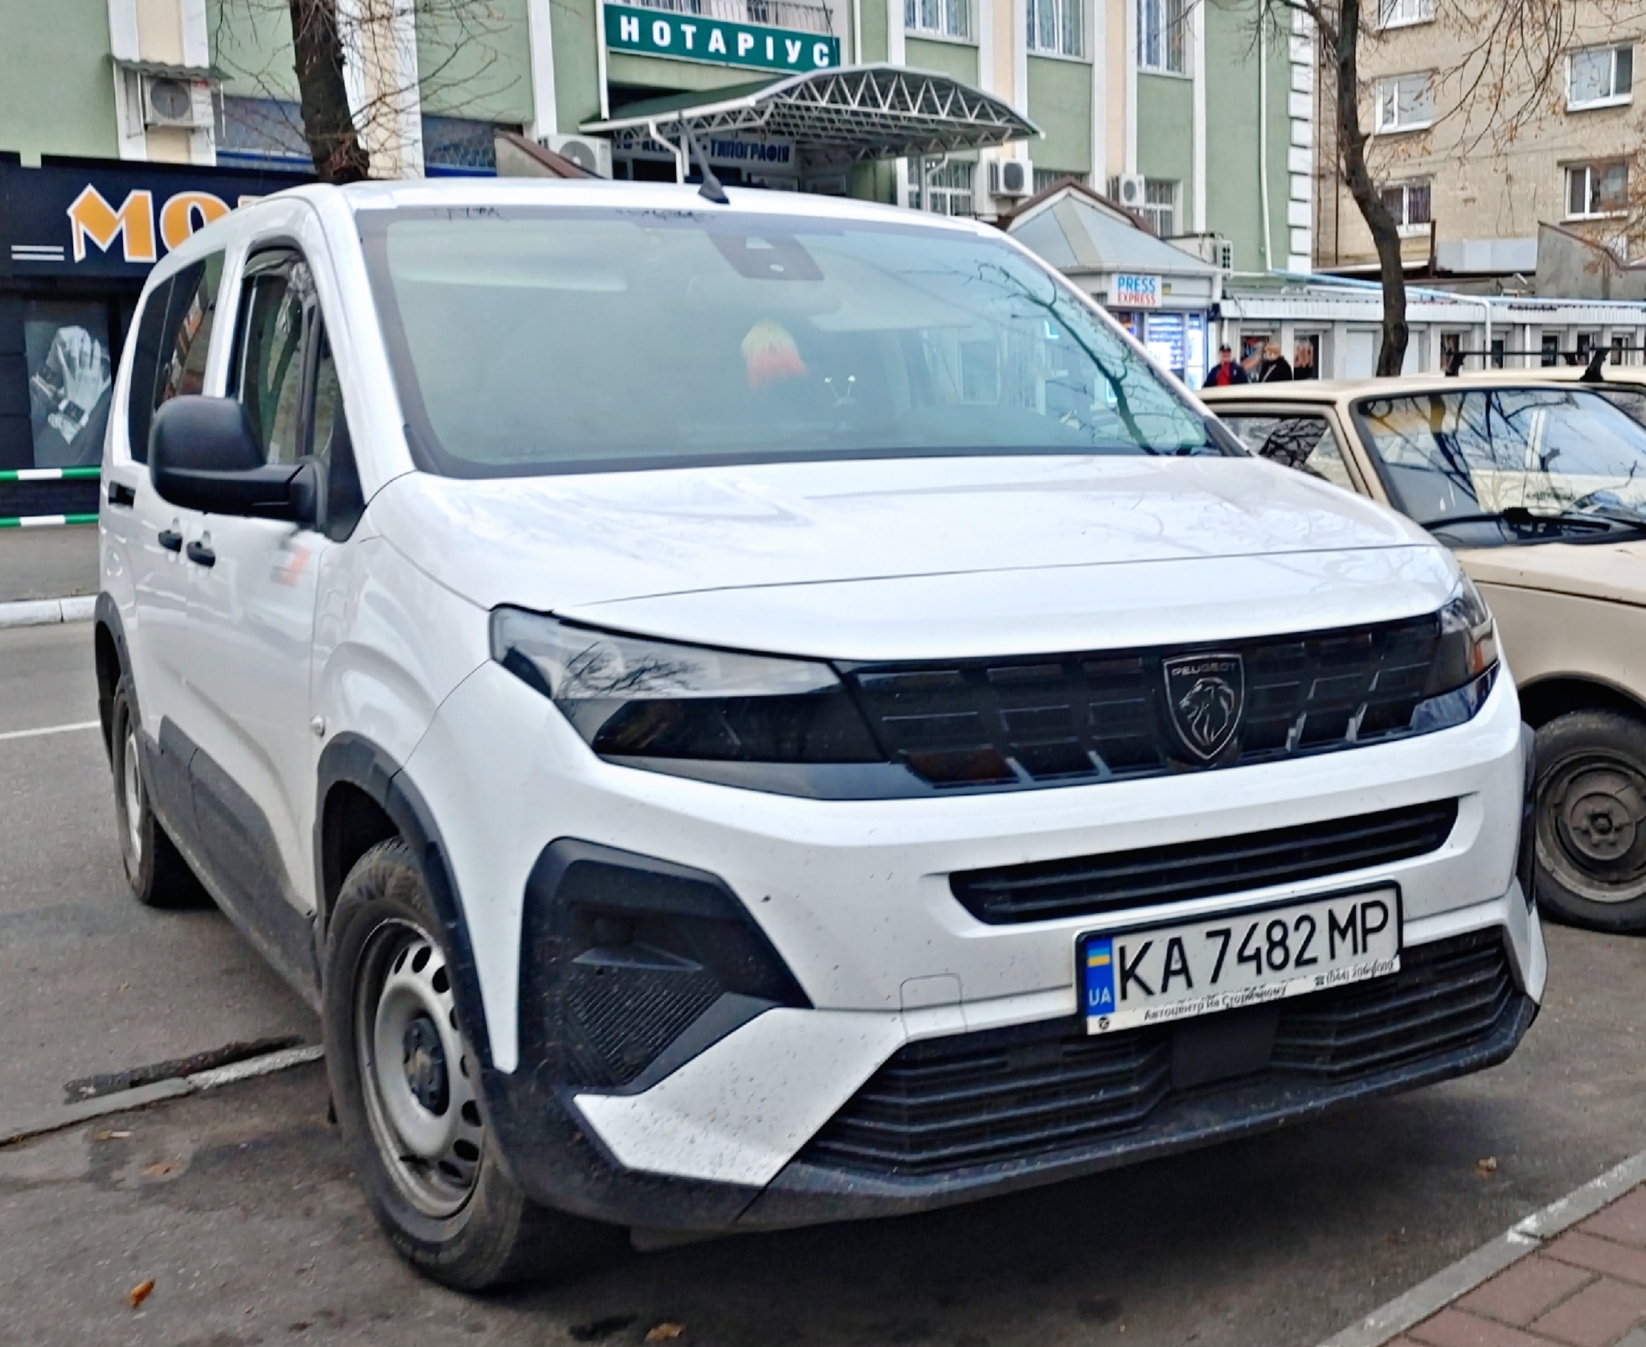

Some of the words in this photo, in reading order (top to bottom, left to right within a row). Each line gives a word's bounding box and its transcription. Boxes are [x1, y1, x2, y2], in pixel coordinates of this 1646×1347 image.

[619, 14, 830, 67] НОТАРІУС
[710, 138, 790, 162] ТИПОГРАФІЯ
[1118, 276, 1156, 293] PRESS
[1118, 292, 1156, 304] EXPRESS
[1171, 662, 1236, 676] PEUGEOT
[1119, 936, 1194, 1001] KA
[1206, 914, 1318, 984] 7482
[1327, 900, 1389, 960] MP
[1088, 987, 1112, 1007] UA
